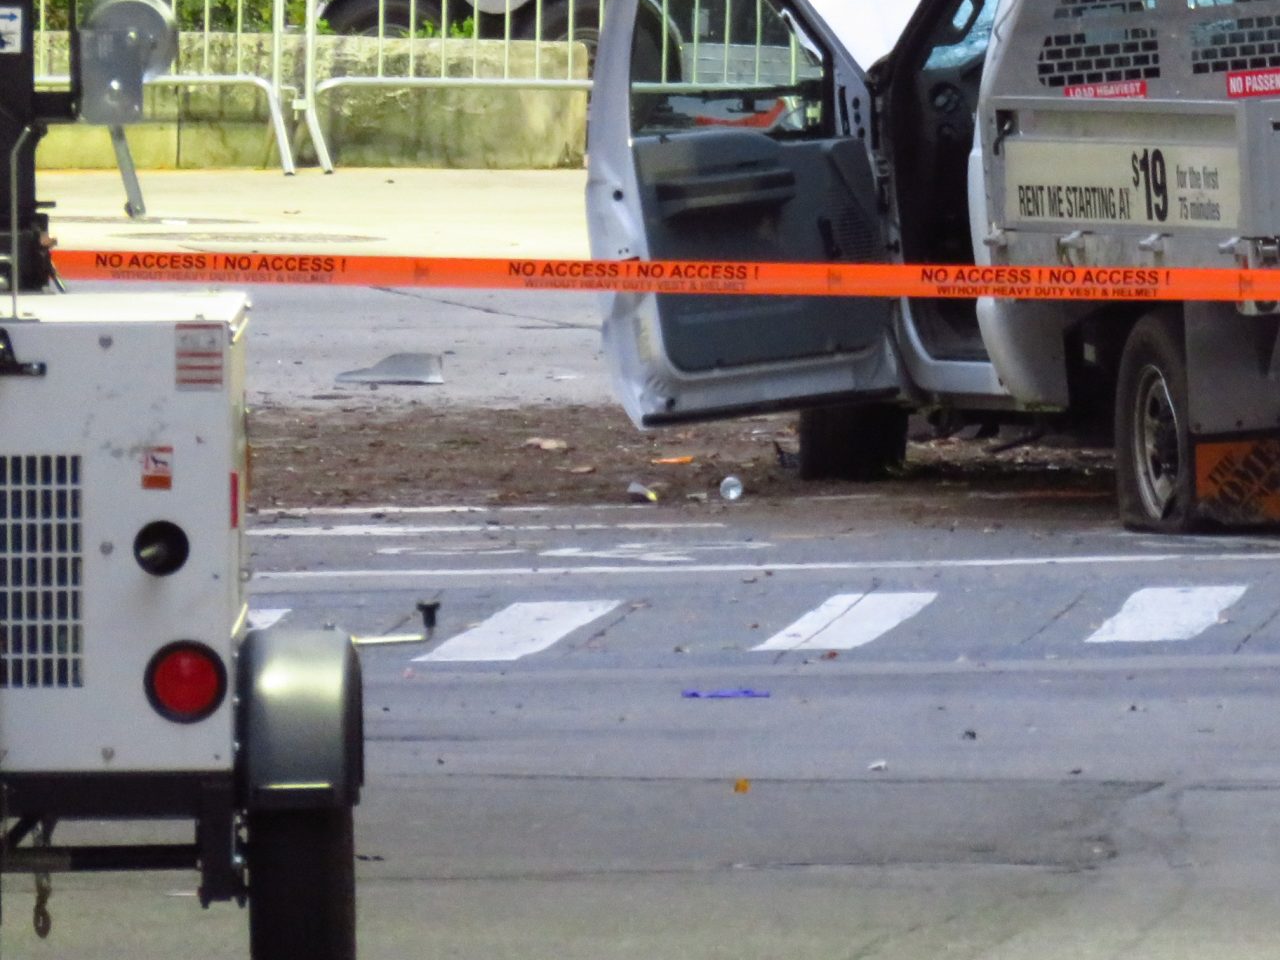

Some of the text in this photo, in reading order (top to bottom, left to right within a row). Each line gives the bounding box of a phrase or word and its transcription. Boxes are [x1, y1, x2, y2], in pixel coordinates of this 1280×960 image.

[1229, 78, 1243, 94] NO
[1018, 148, 1168, 222] RENT ME STARTING AT $19
[1176, 164, 1219, 190] for the first
[1178, 197, 1221, 221] 75 minutes
[95, 254, 123, 268] NO
[128, 255, 206, 270] ACCESS
[224, 256, 252, 271] NO
[257, 257, 335, 272] ACCESS
[508, 262, 536, 276] NO
[541, 263, 619, 277] ACCESS
[637, 264, 664, 279] NO
[670, 265, 747, 280] ACCESS
[921, 269, 948, 283] NO
[954, 269, 1031, 284] ACCESS
[1049, 270, 1076, 284] NO
[1082, 271, 1159, 285] ACCESS
[937, 285, 989, 295] WITHOUT
[993, 285, 1030, 296] HEAVY
[1035, 286, 1065, 296] DUTY
[1069, 286, 1099, 296] VEST
[1112, 287, 1157, 297] HELMET
